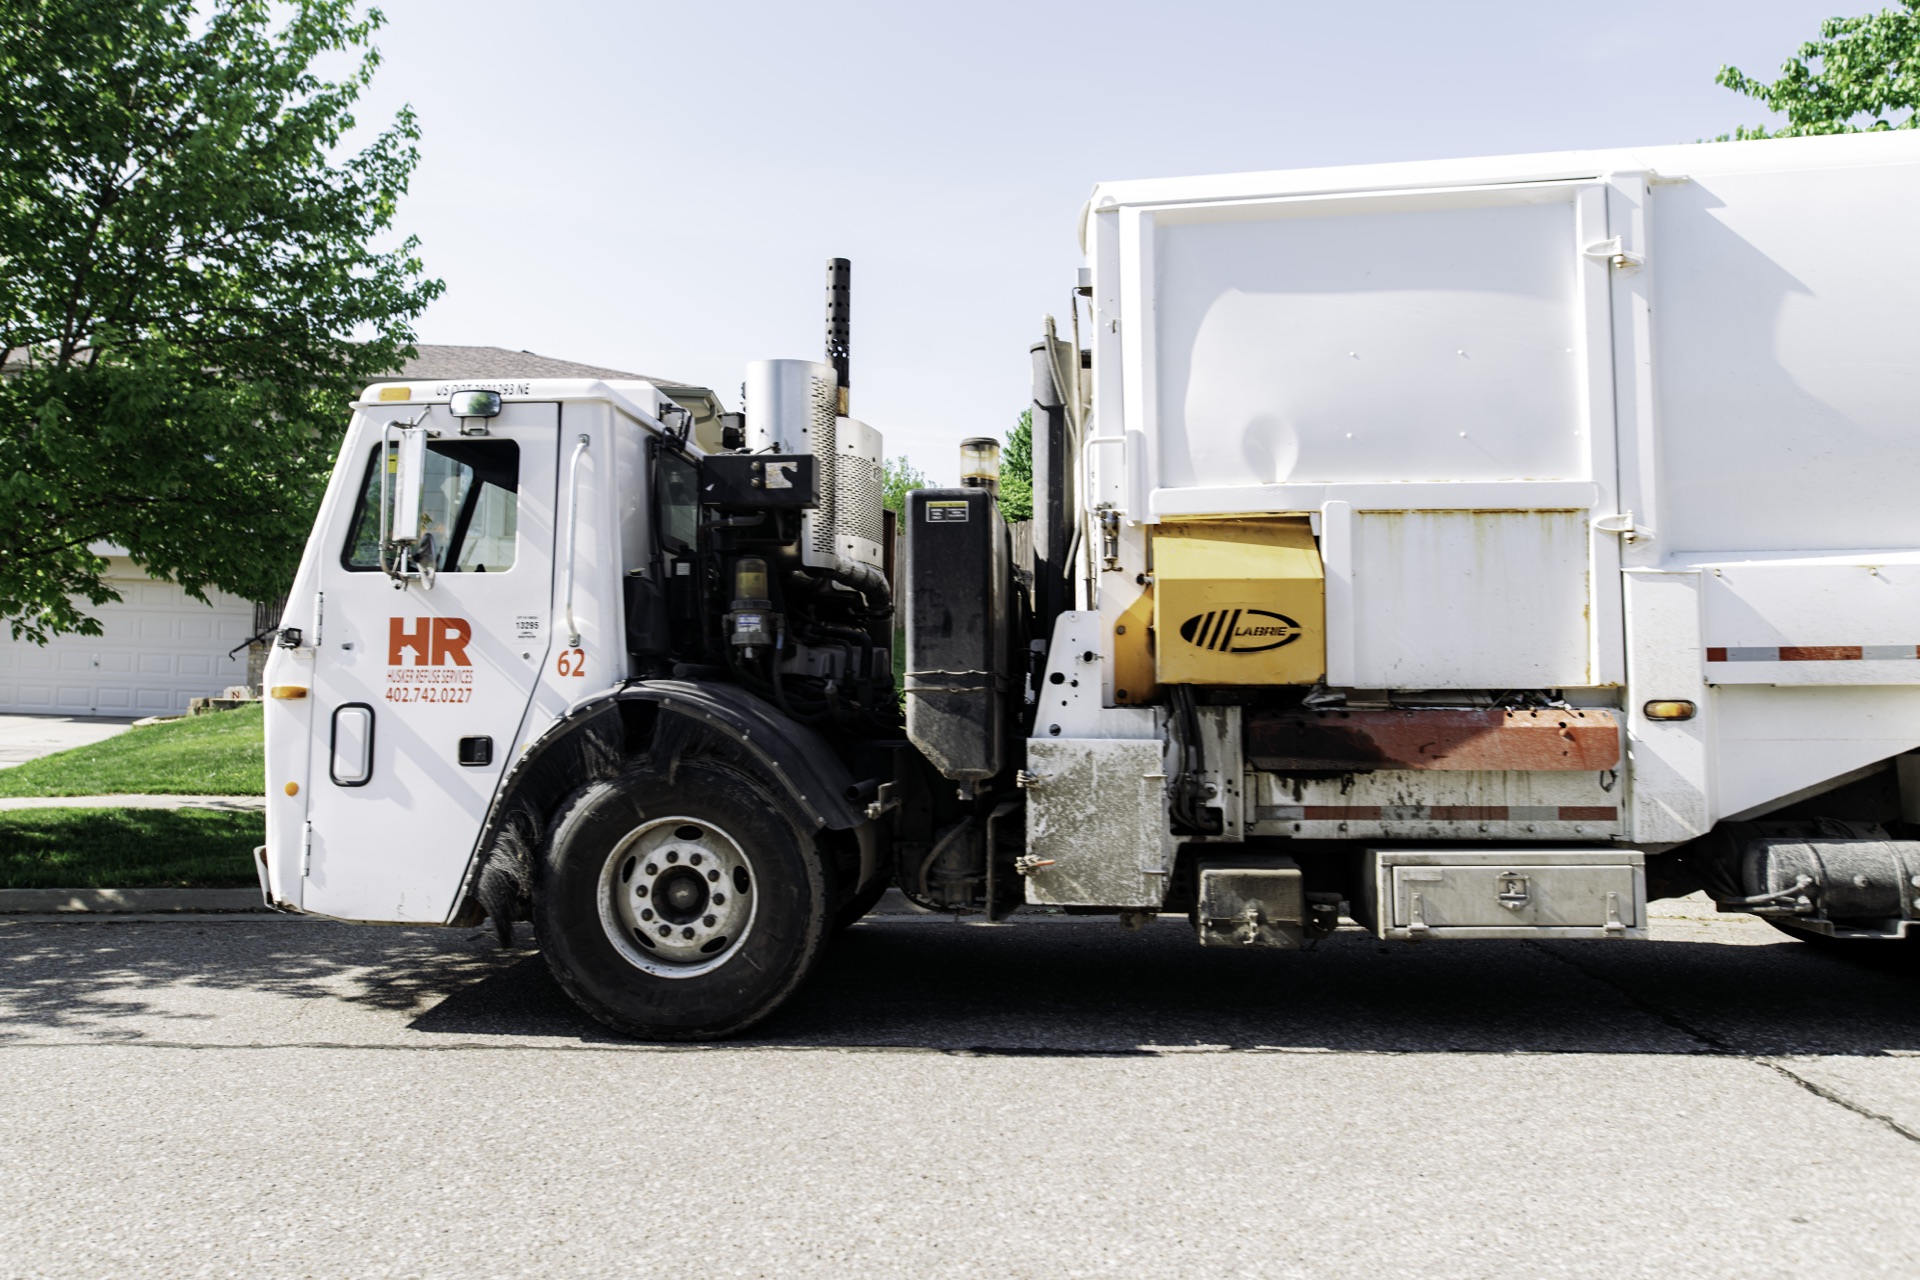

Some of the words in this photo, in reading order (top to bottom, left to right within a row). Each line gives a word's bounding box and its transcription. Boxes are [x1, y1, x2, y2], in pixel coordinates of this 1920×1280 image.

[436, 384, 449, 396] US
[516, 383, 530, 395] NE
[1234, 626, 1288, 637] LABRIE
[388, 617, 473, 666] HR
[557, 648, 585, 677] 62
[386, 669, 414, 683] HUSKER
[415, 669, 440, 684] REFUSE
[441, 669, 473, 684] SERVICES
[232, 691, 240, 699] N
[386, 687, 472, 703] 402.742.0227
